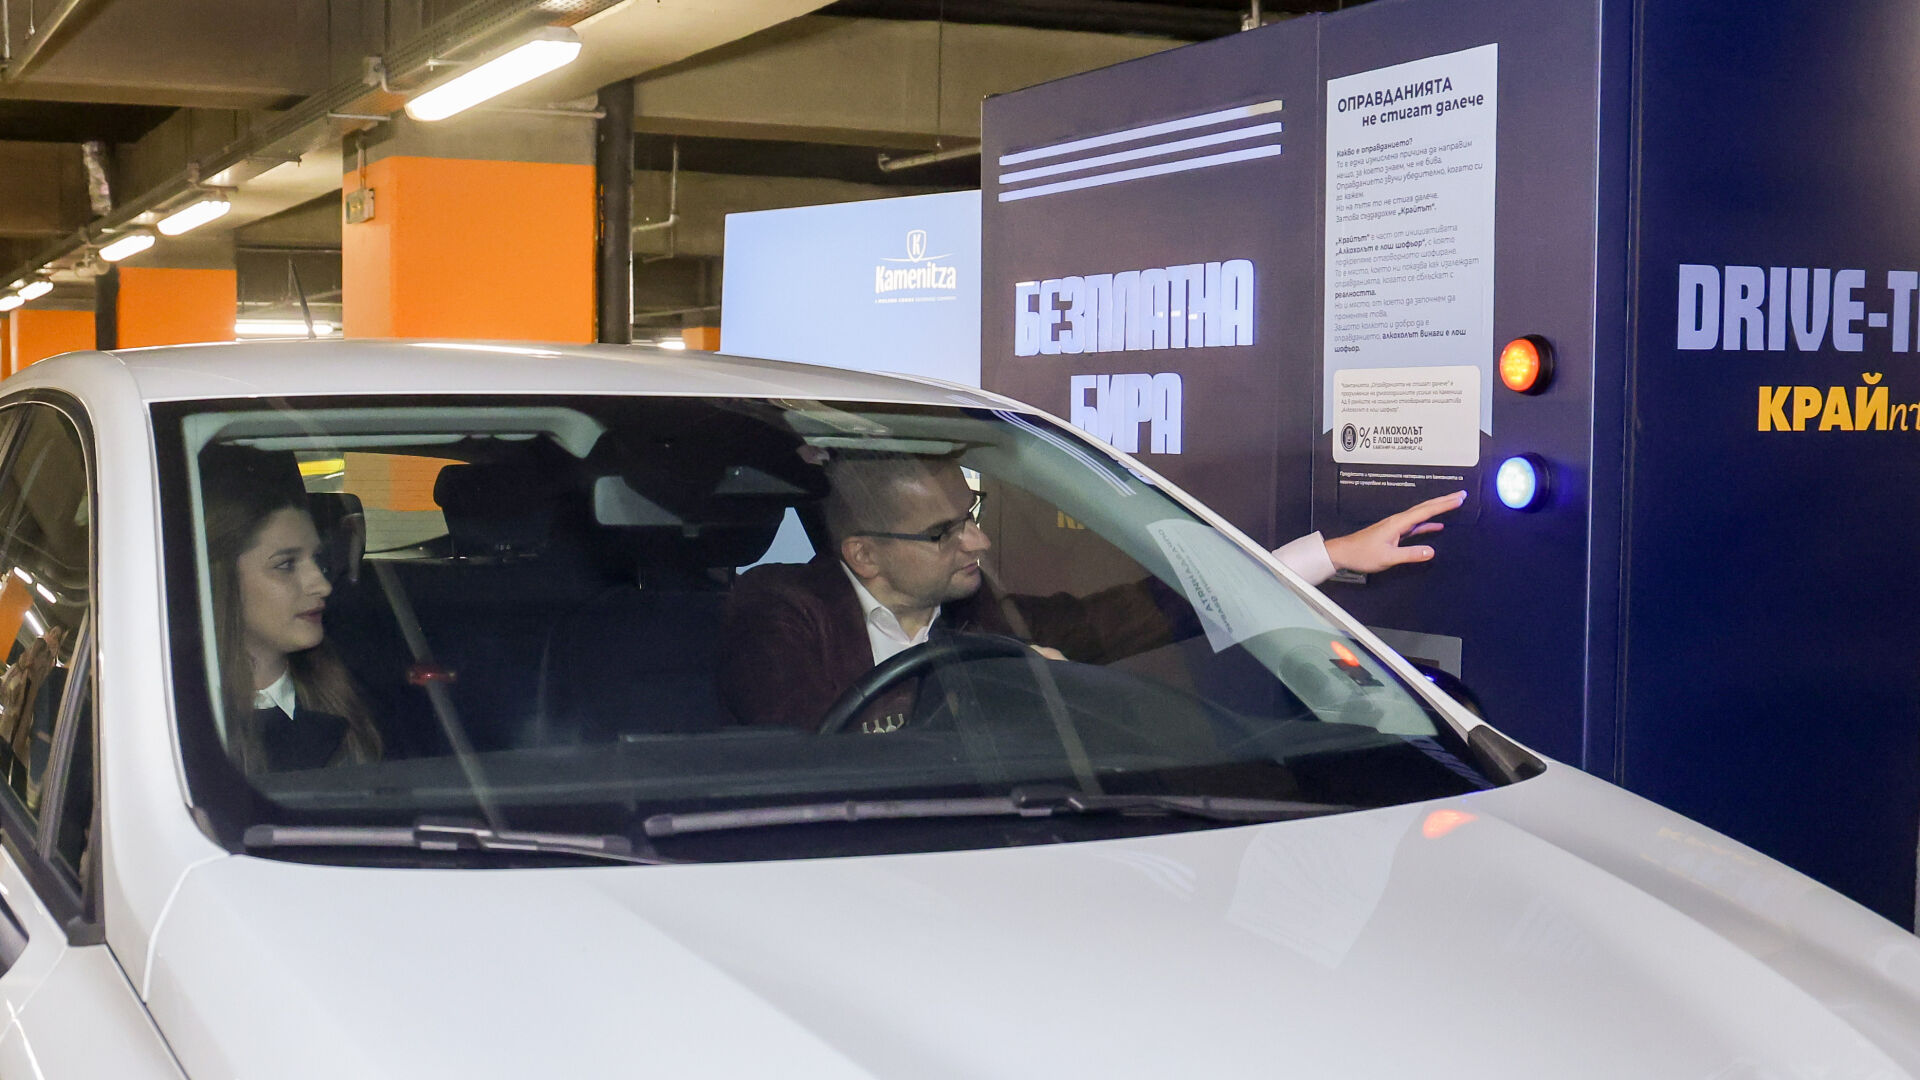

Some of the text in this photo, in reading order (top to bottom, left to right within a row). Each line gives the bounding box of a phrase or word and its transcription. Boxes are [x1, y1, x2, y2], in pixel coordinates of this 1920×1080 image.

[1338, 77, 1452, 112] ОПРАВДАНИЯТА
[1362, 94, 1484, 126] не стигат далече
[1337, 147, 1354, 157] Какво
[1362, 138, 1413, 154] оправданието?
[1350, 159, 1364, 167] една
[1366, 154, 1398, 165] измислена
[1400, 148, 1427, 159] причина
[1429, 147, 1437, 155] да
[1439, 140, 1472, 152] направим
[1336, 178, 1383, 190] Оправданието
[1447, 164, 1473, 174] когато
[1475, 162, 1483, 170] си
[1364, 166, 1383, 174] което
[1393, 194, 1413, 205] стига
[875, 262, 956, 294] Kamenitza
[1015, 259, 1254, 356] БЕЗПЛАТНА
[1677, 263, 1920, 352] DRIVE-T
[1382, 331, 1419, 340] алкохолът
[1420, 330, 1443, 338] винаги
[1070, 372, 1182, 454] БИРА
[1373, 426, 1423, 435] АЛКОХОЛЪТ
[1378, 436, 1392, 444] ЛОШ
[1393, 436, 1423, 444] ШОФЬОР
